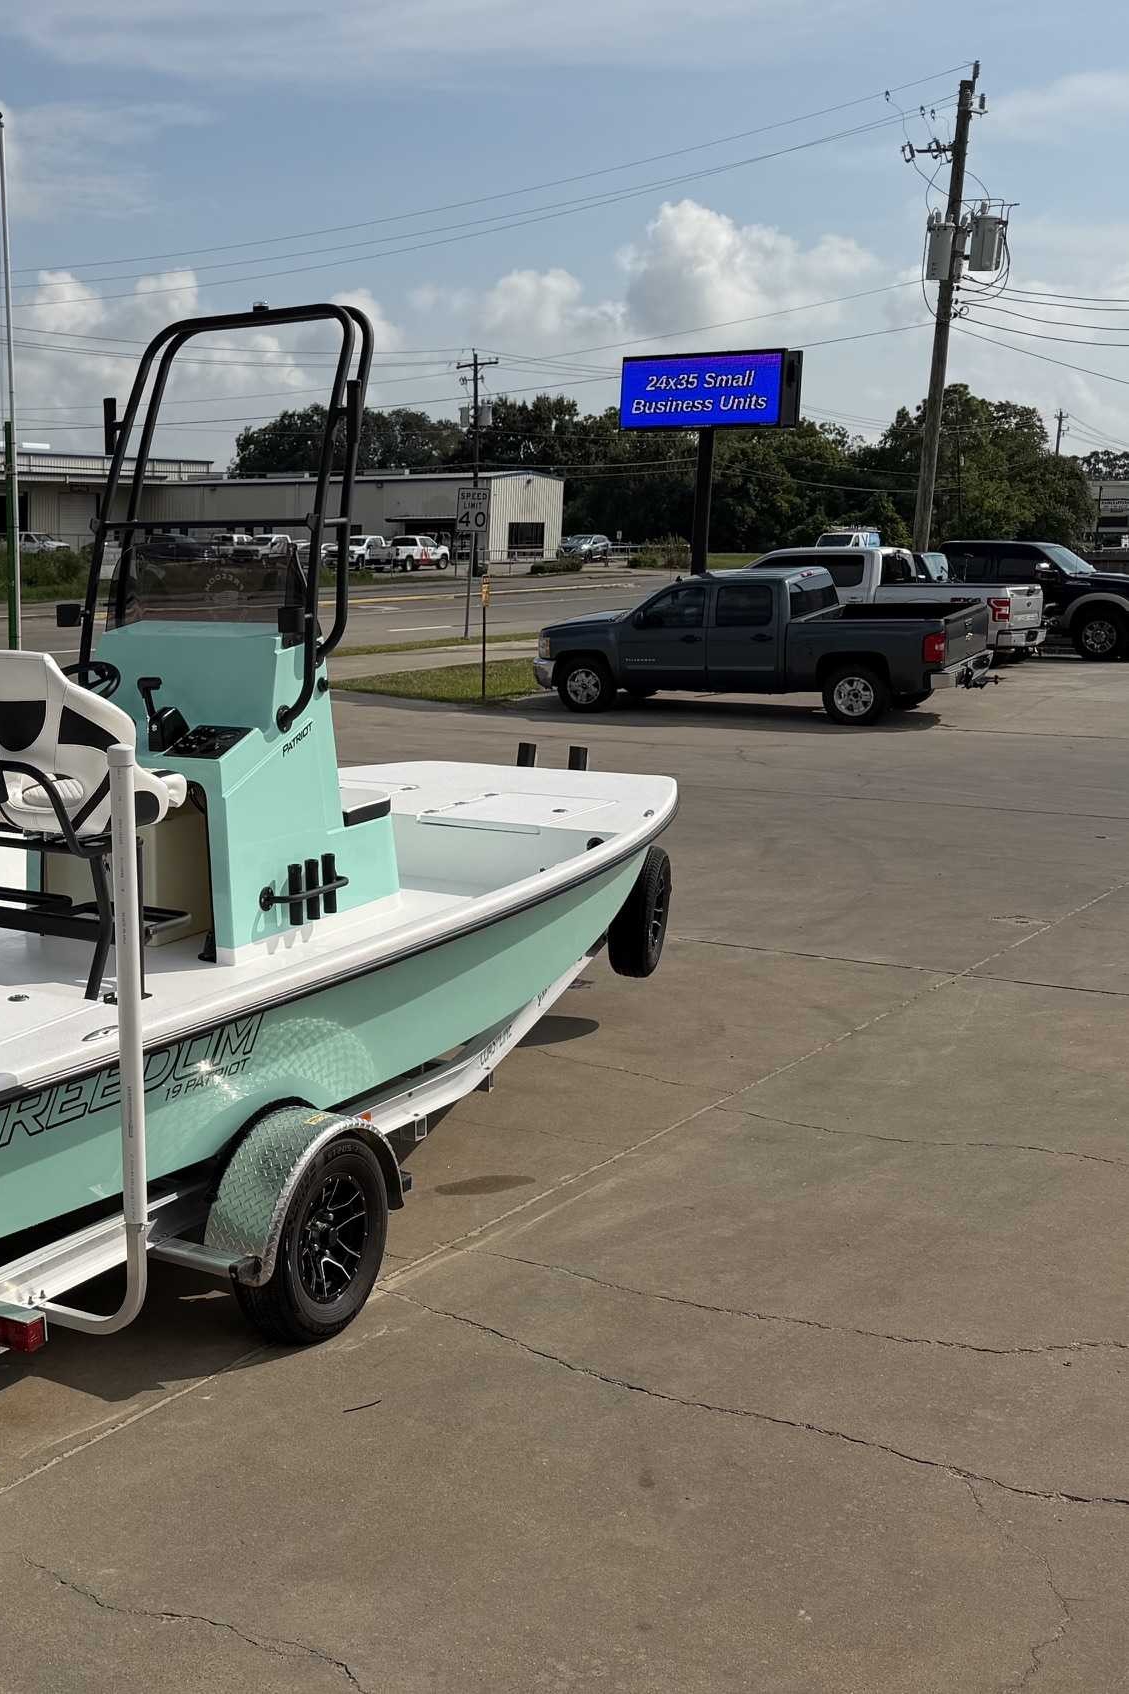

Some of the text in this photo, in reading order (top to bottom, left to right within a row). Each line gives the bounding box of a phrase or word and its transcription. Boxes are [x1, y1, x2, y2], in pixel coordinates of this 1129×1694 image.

[646, 370, 755, 390] 24x35 Small
[631, 393, 768, 414] Business Units
[460, 492, 488, 500] SPEED
[463, 501, 482, 510] LIMIT
[458, 511, 486, 528] 40
[282, 721, 314, 758] PATRIOT
[165, 1083, 183, 1101] 19
